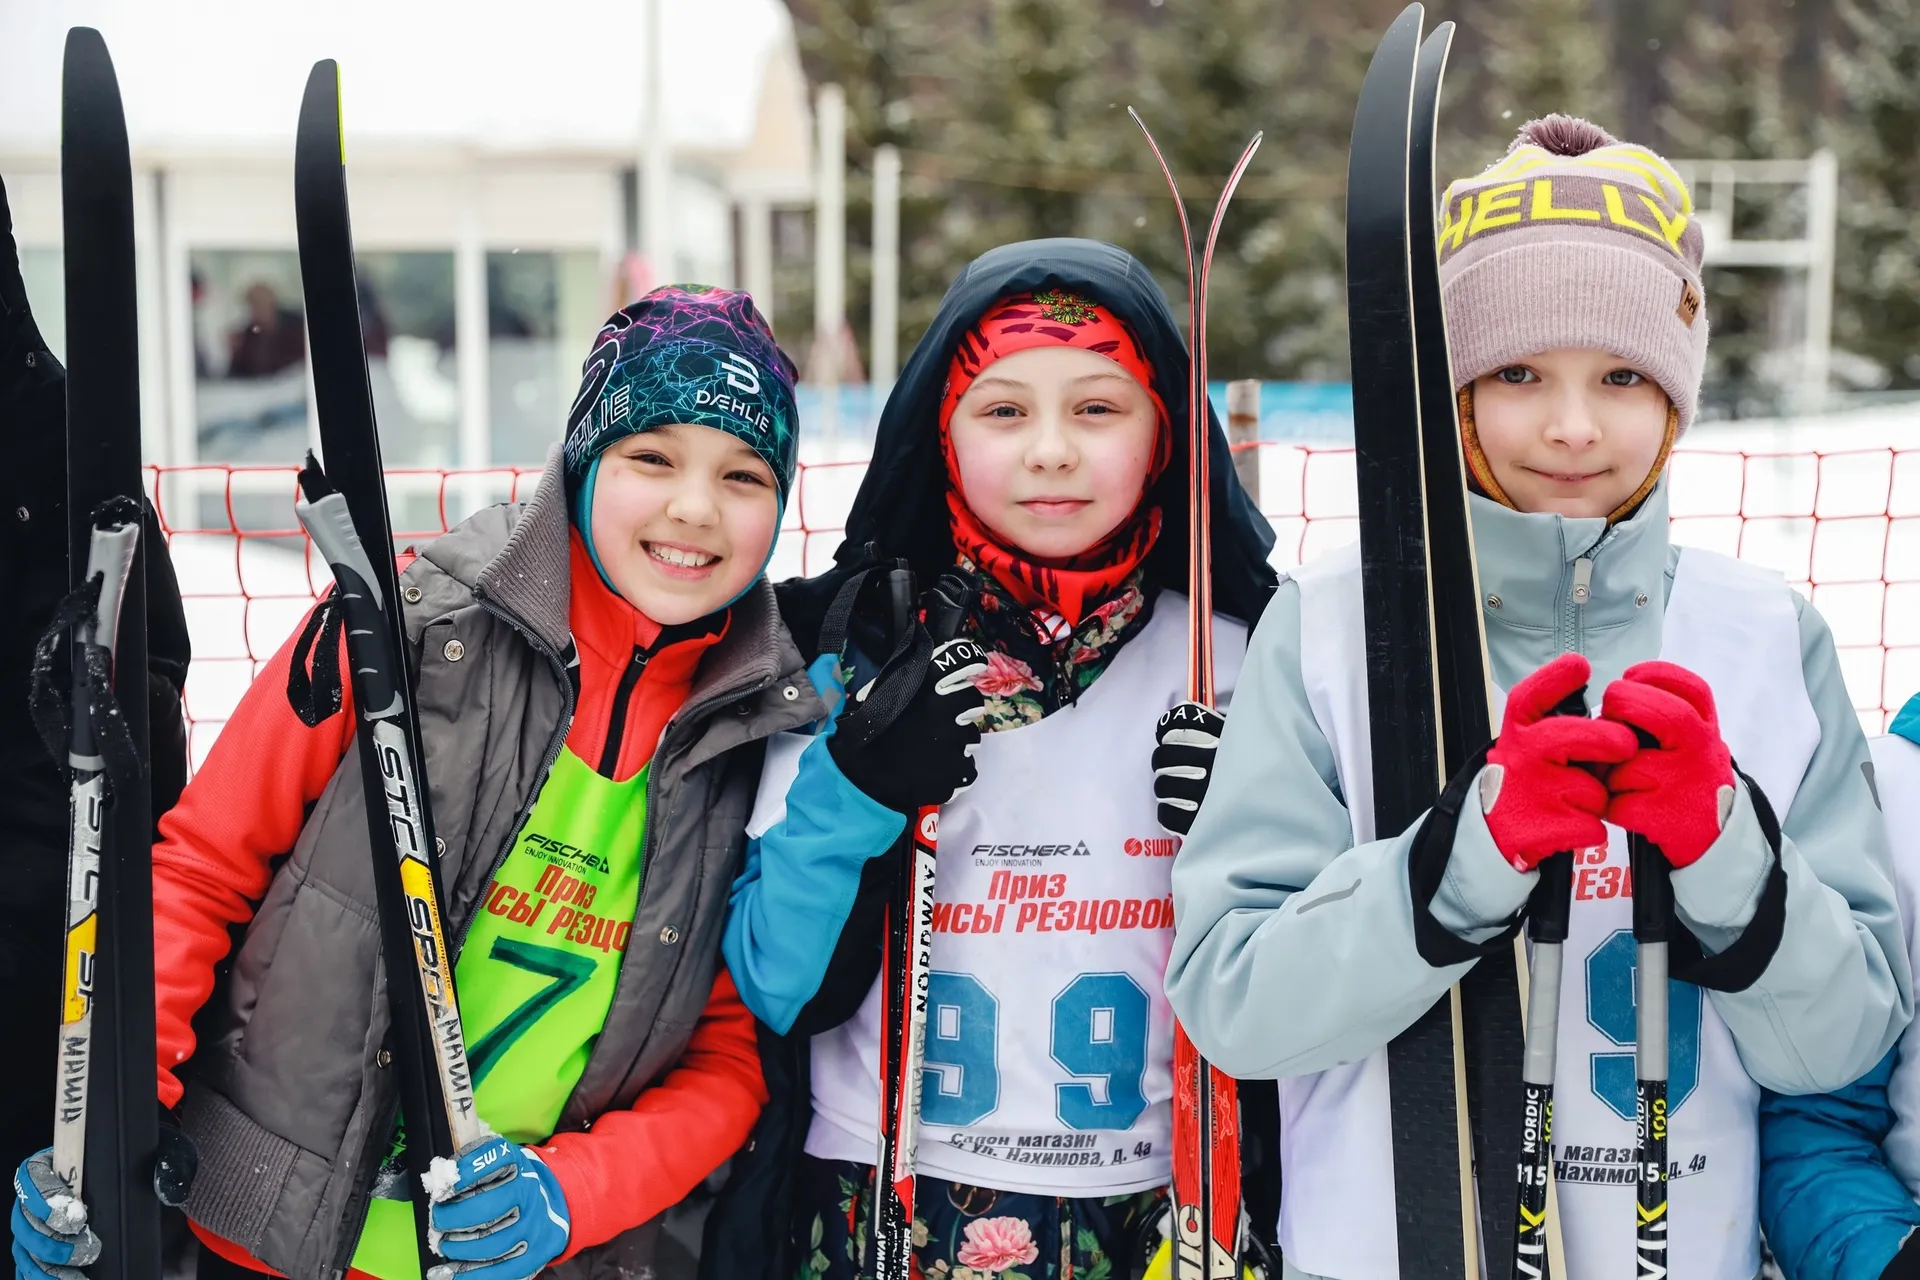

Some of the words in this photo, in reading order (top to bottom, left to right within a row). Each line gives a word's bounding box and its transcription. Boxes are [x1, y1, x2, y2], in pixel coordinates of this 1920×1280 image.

[1438, 179, 1687, 257] HELLY
[1684, 292, 1699, 316] HH
[696, 389, 770, 434] DÆHLIE
[375, 740, 418, 858] STC
[524, 846, 547, 860] ENJOY
[547, 853, 587, 875] INNOVATION
[971, 844, 1072, 858] FISCHER
[975, 858, 998, 867] ENJOY
[1001, 859, 1042, 867] INNOVATION
[1144, 838, 1174, 857] SWIX
[534, 863, 597, 910] Приз
[988, 870, 1067, 904] Приз
[1571, 866, 1633, 901] ЕЗ
[466, 936, 598, 1093] 7
[1523, 1088, 1539, 1153] NORDIC
[1652, 1098, 1667, 1140] 100
[1005, 1147, 1104, 1167] Нахимова,
[1017, 1134, 1097, 1148] магазин
[472, 1142, 511, 1173] SWX
[1517, 1163, 1547, 1186] 115
